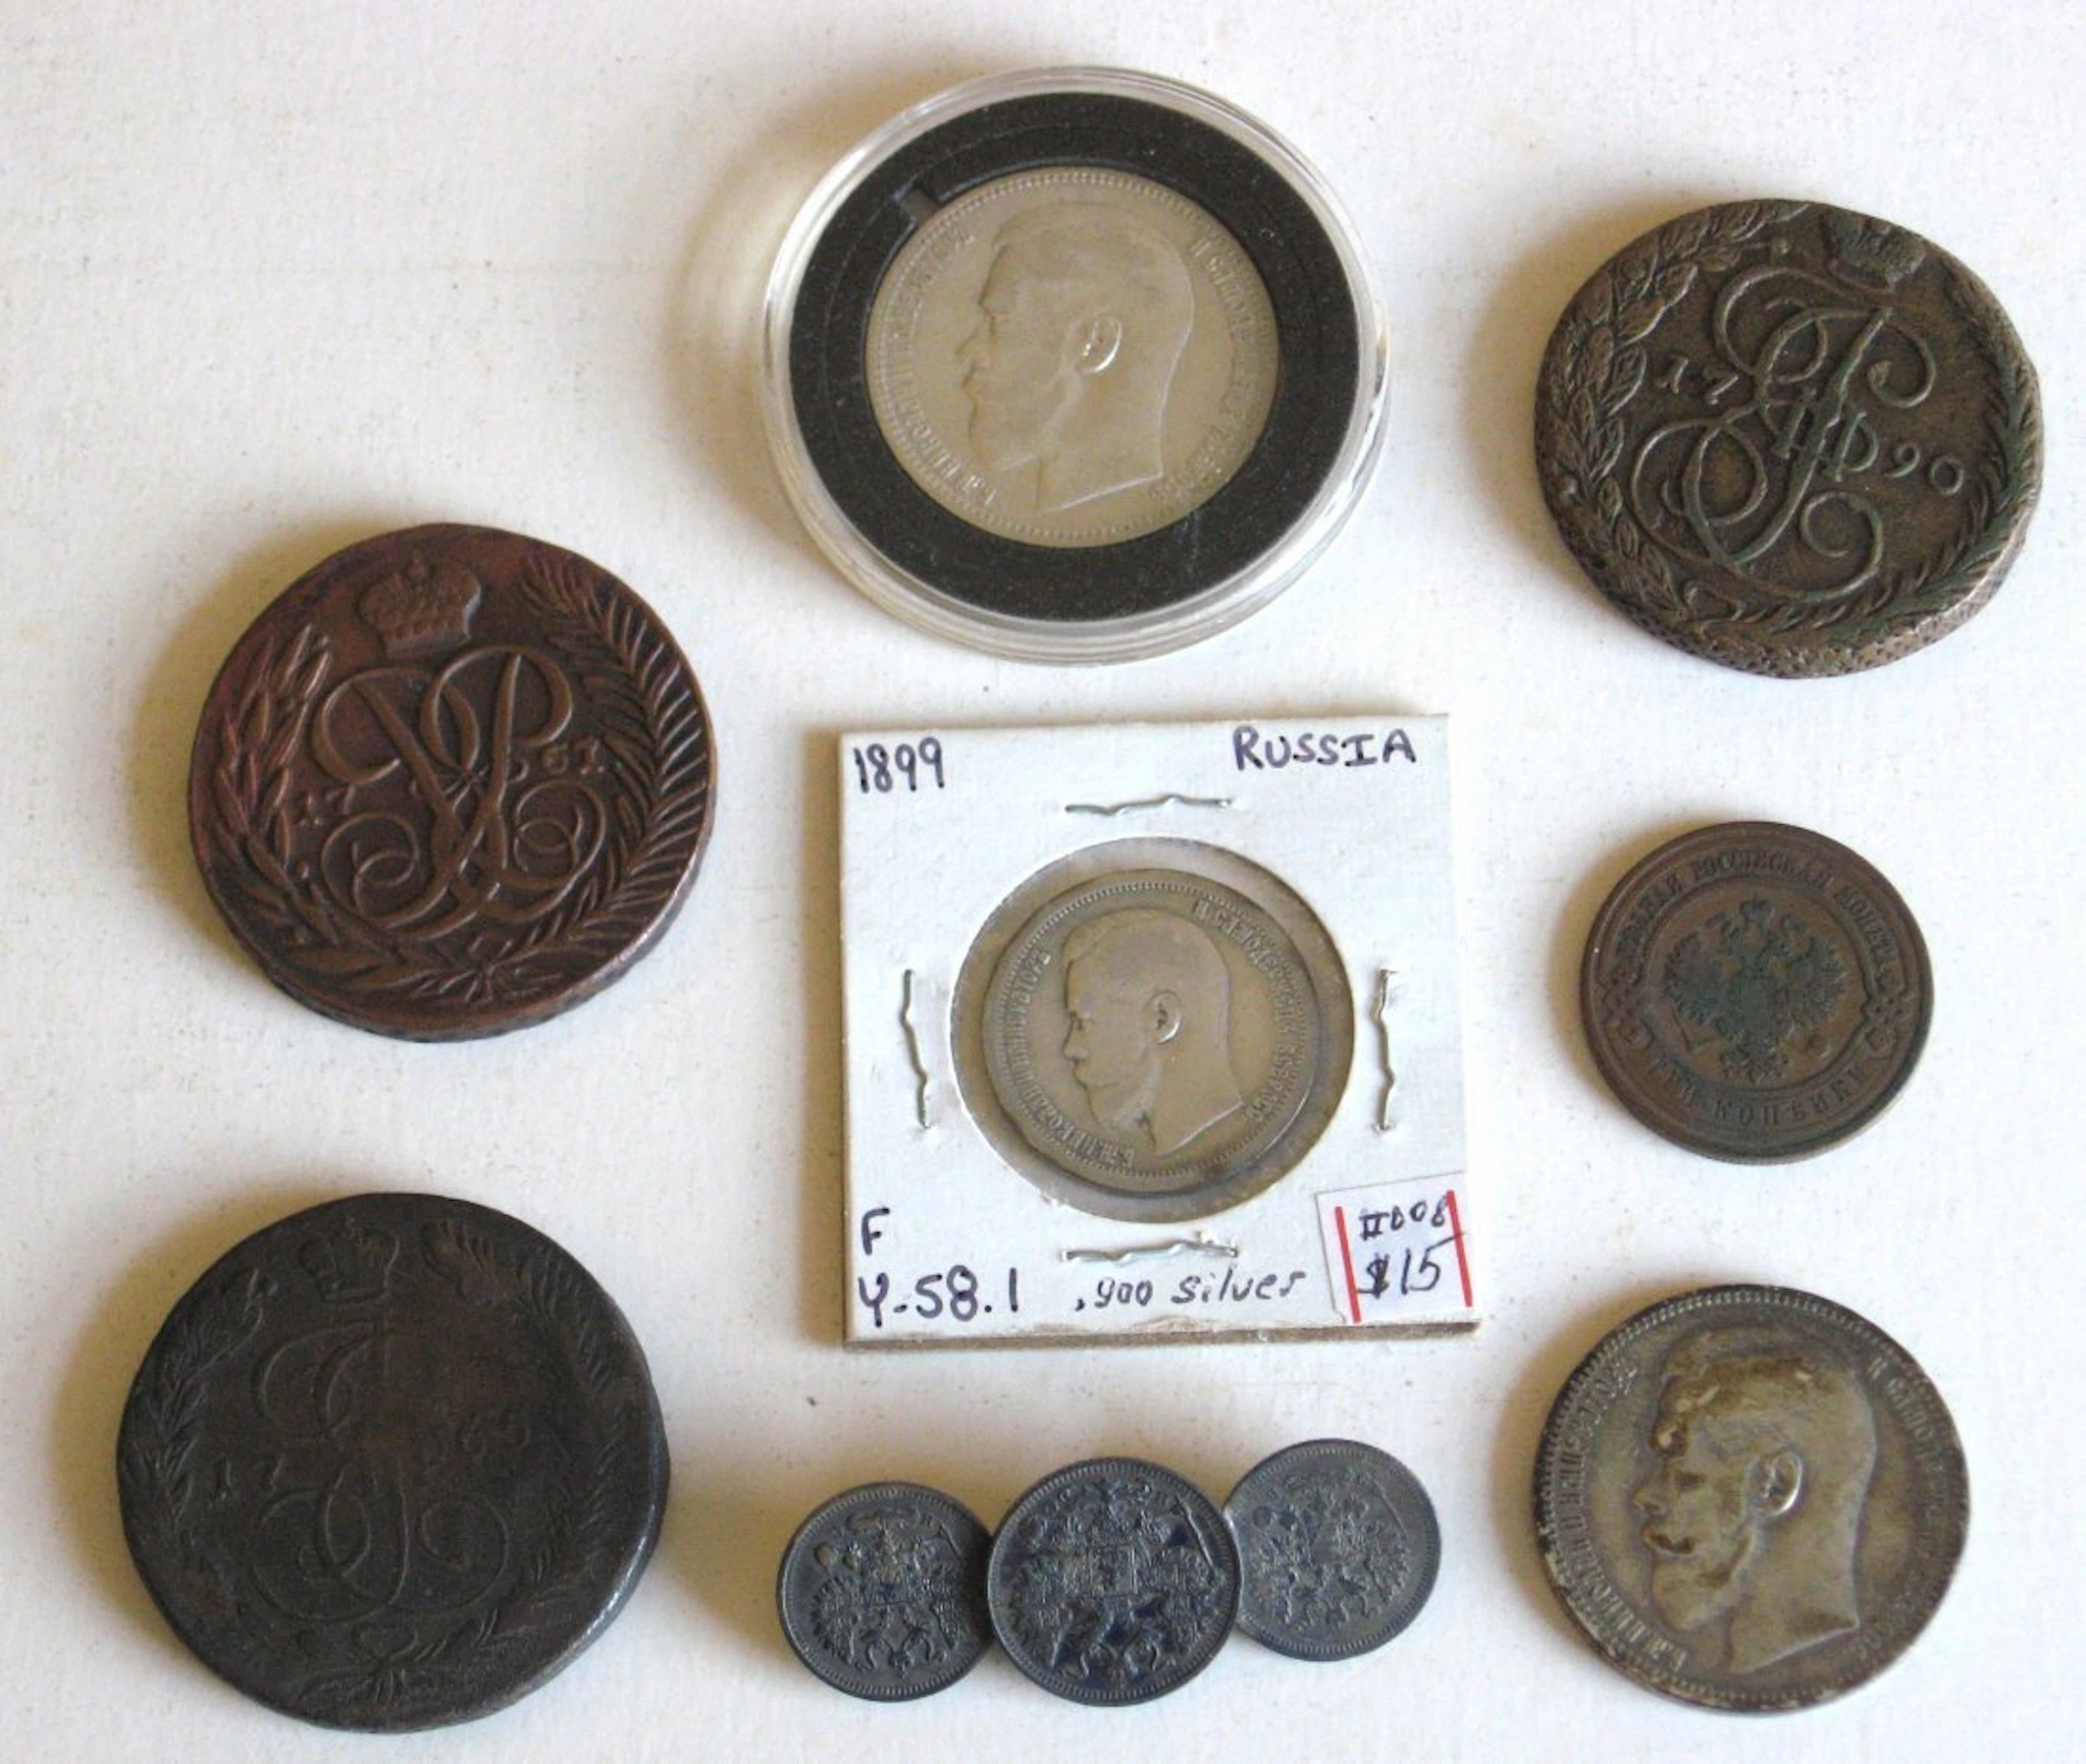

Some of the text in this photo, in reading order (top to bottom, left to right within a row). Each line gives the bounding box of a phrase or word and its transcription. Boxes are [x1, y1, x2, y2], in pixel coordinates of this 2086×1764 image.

[853, 736, 945, 794] 1899
[1233, 725, 1417, 771] RUSSIA
[860, 1207, 890, 1257] F
[1170, 1263, 1306, 1304] silver
[1357, 1232, 1462, 1300] $15
